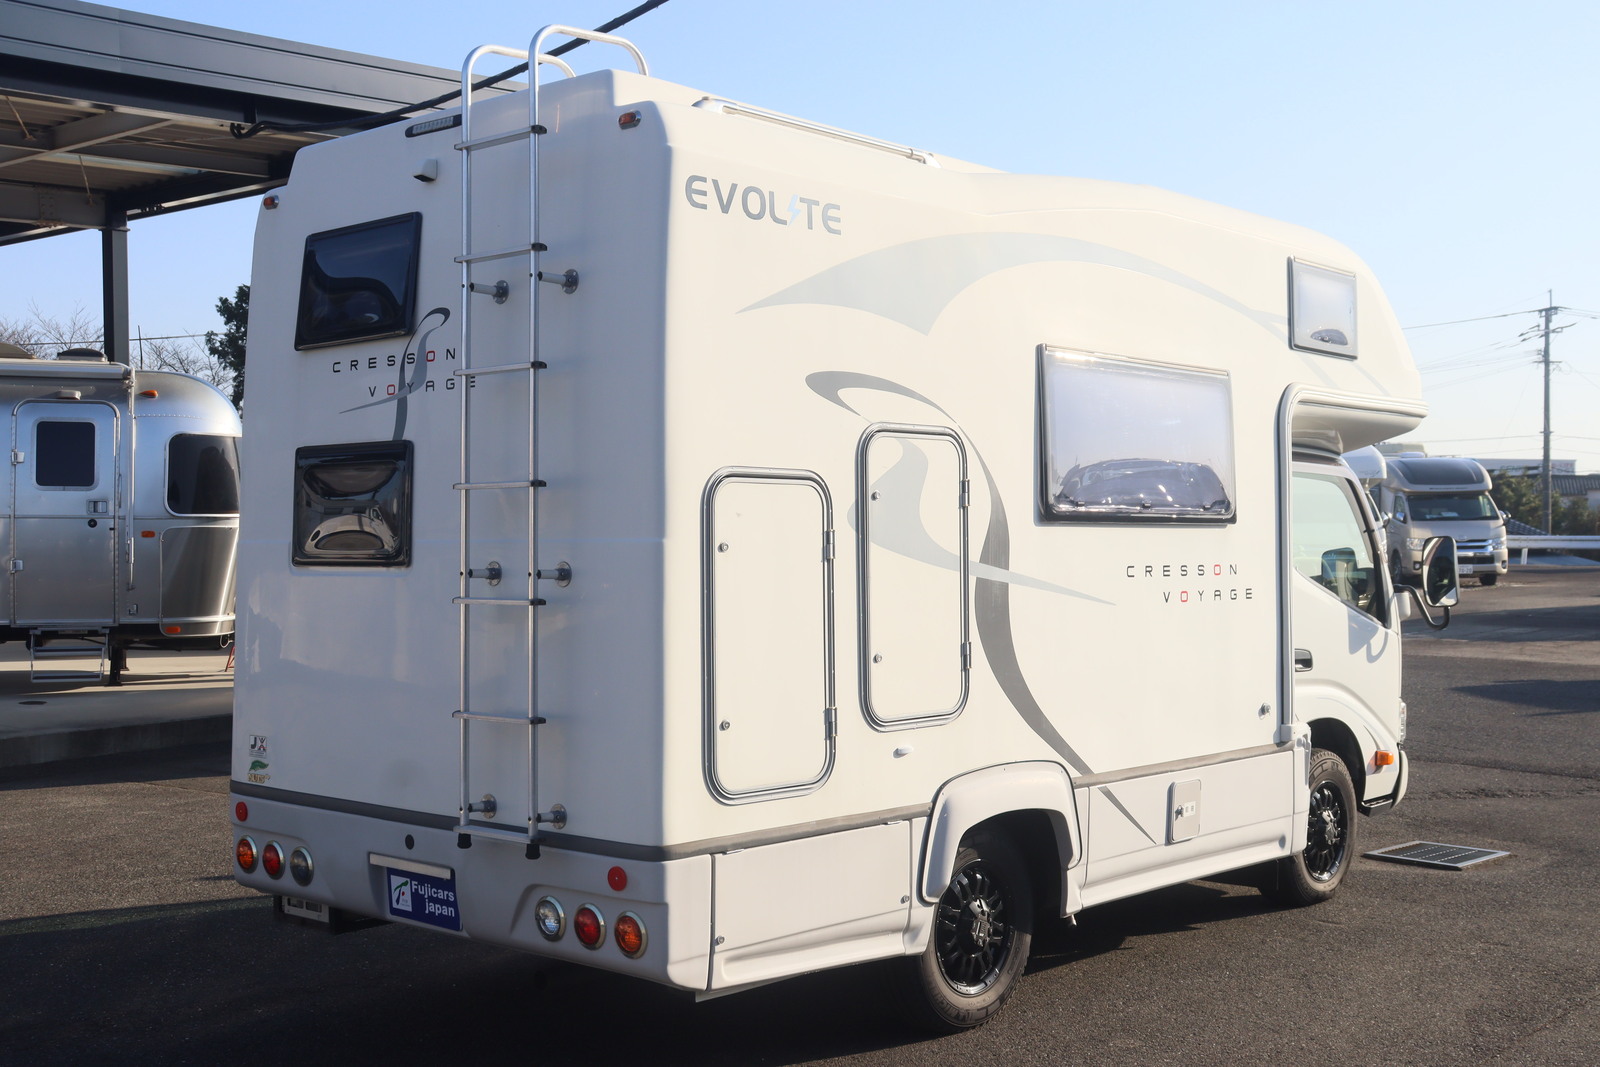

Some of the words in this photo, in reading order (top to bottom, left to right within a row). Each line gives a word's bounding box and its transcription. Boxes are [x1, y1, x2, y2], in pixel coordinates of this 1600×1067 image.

[332, 348, 456, 373] CRESSON
[1126, 564, 1238, 578] CRESSON
[1162, 588, 1253, 603] VOYAGE
[411, 880, 455, 902] Fujicars
[425, 898, 455, 918] japan
